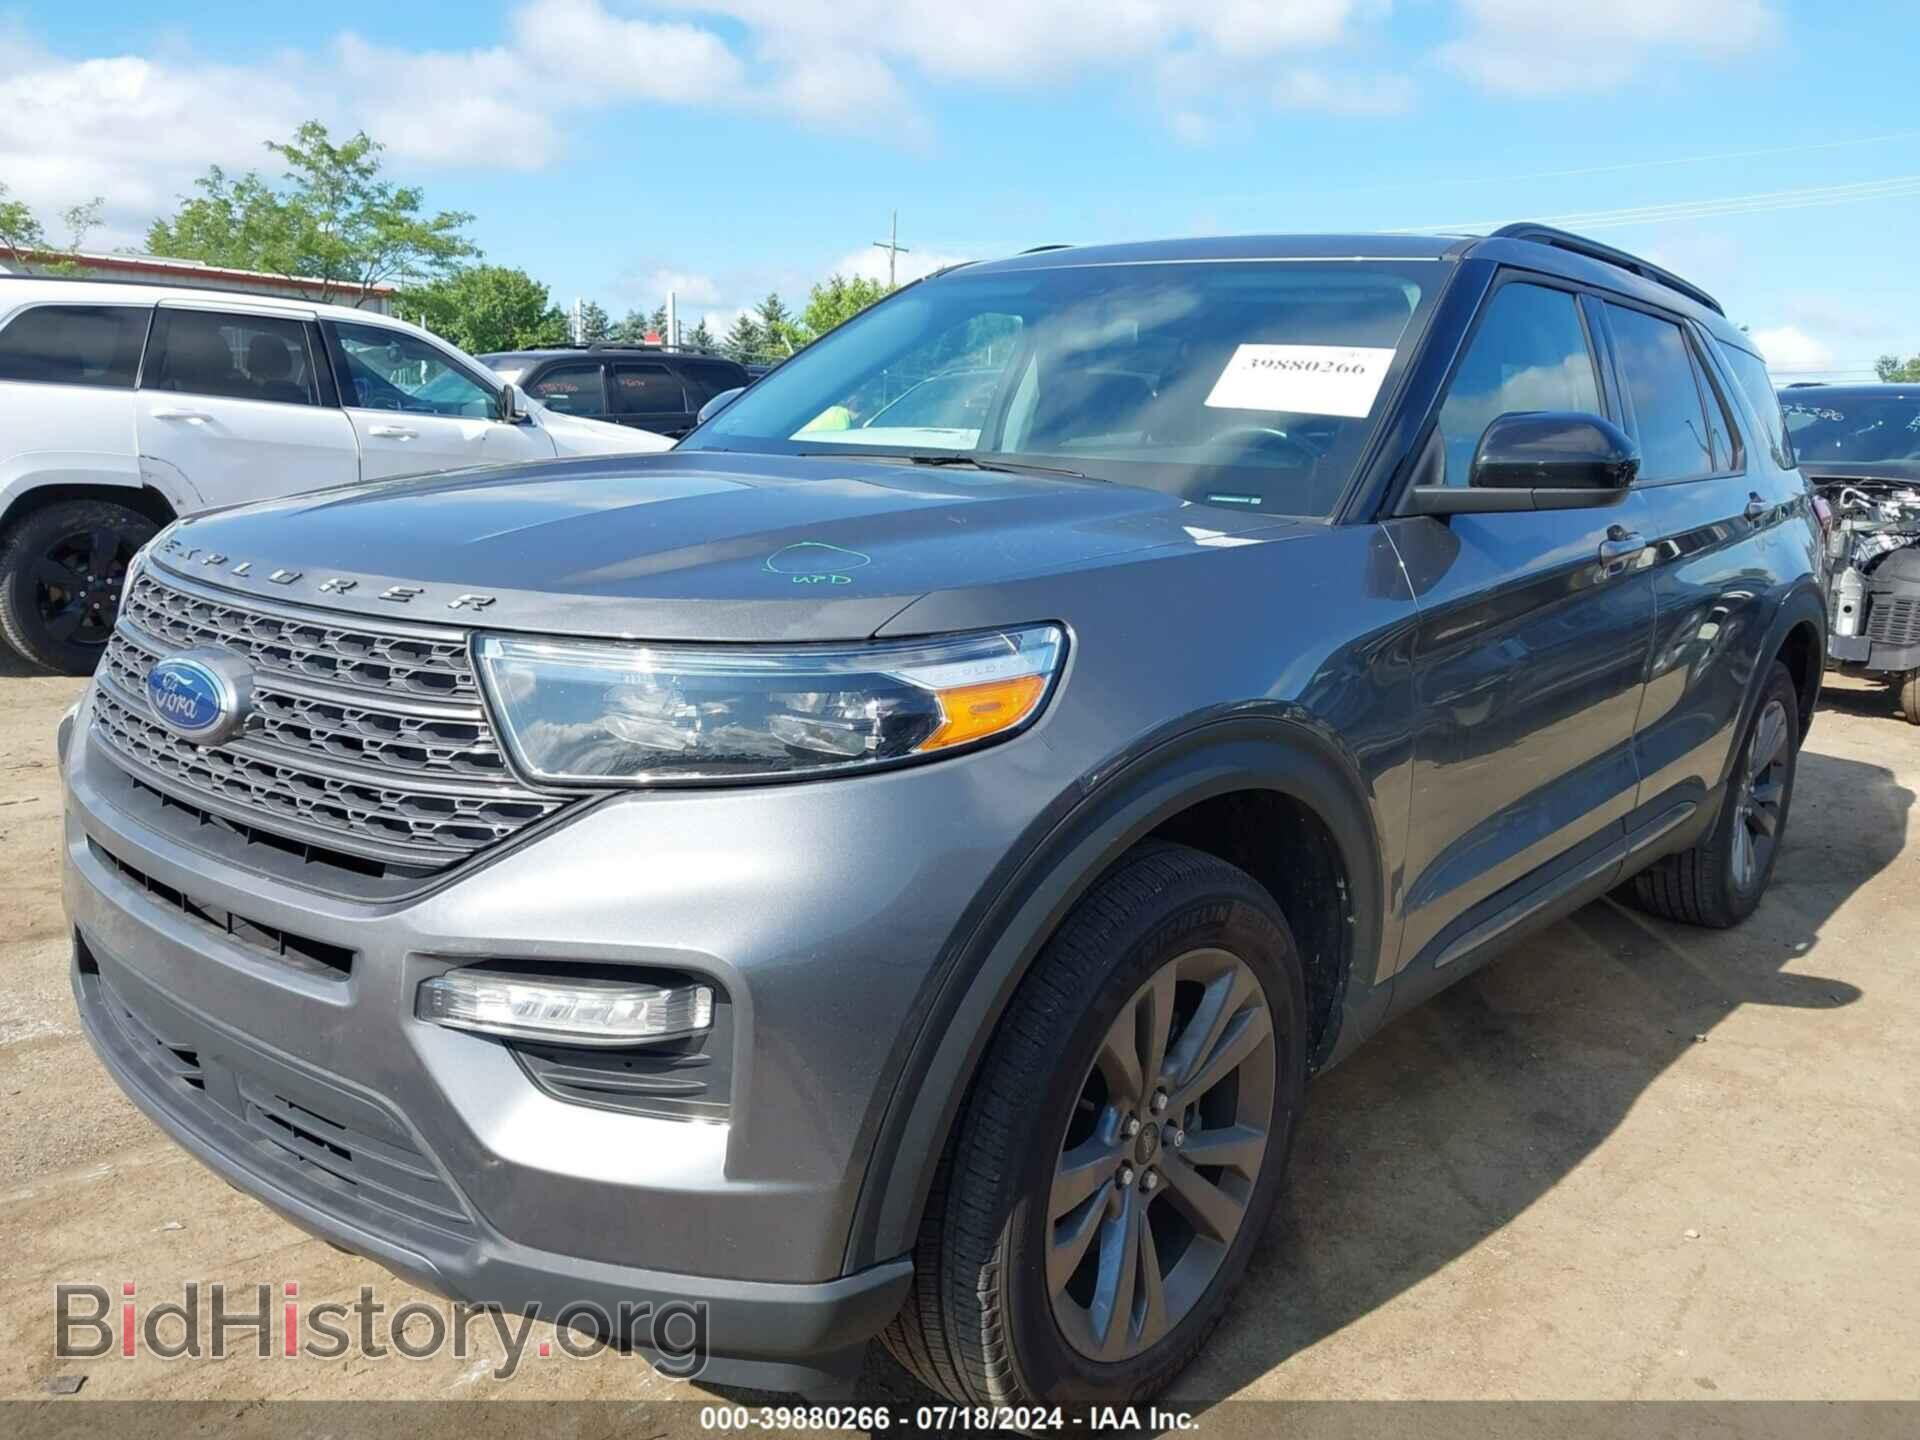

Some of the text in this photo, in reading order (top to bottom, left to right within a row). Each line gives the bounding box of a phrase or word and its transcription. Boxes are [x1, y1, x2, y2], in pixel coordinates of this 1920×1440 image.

[1243, 357, 1366, 376] 39880266
[163, 539, 497, 611] EXPLORER
[156, 671, 203, 719] Ford
